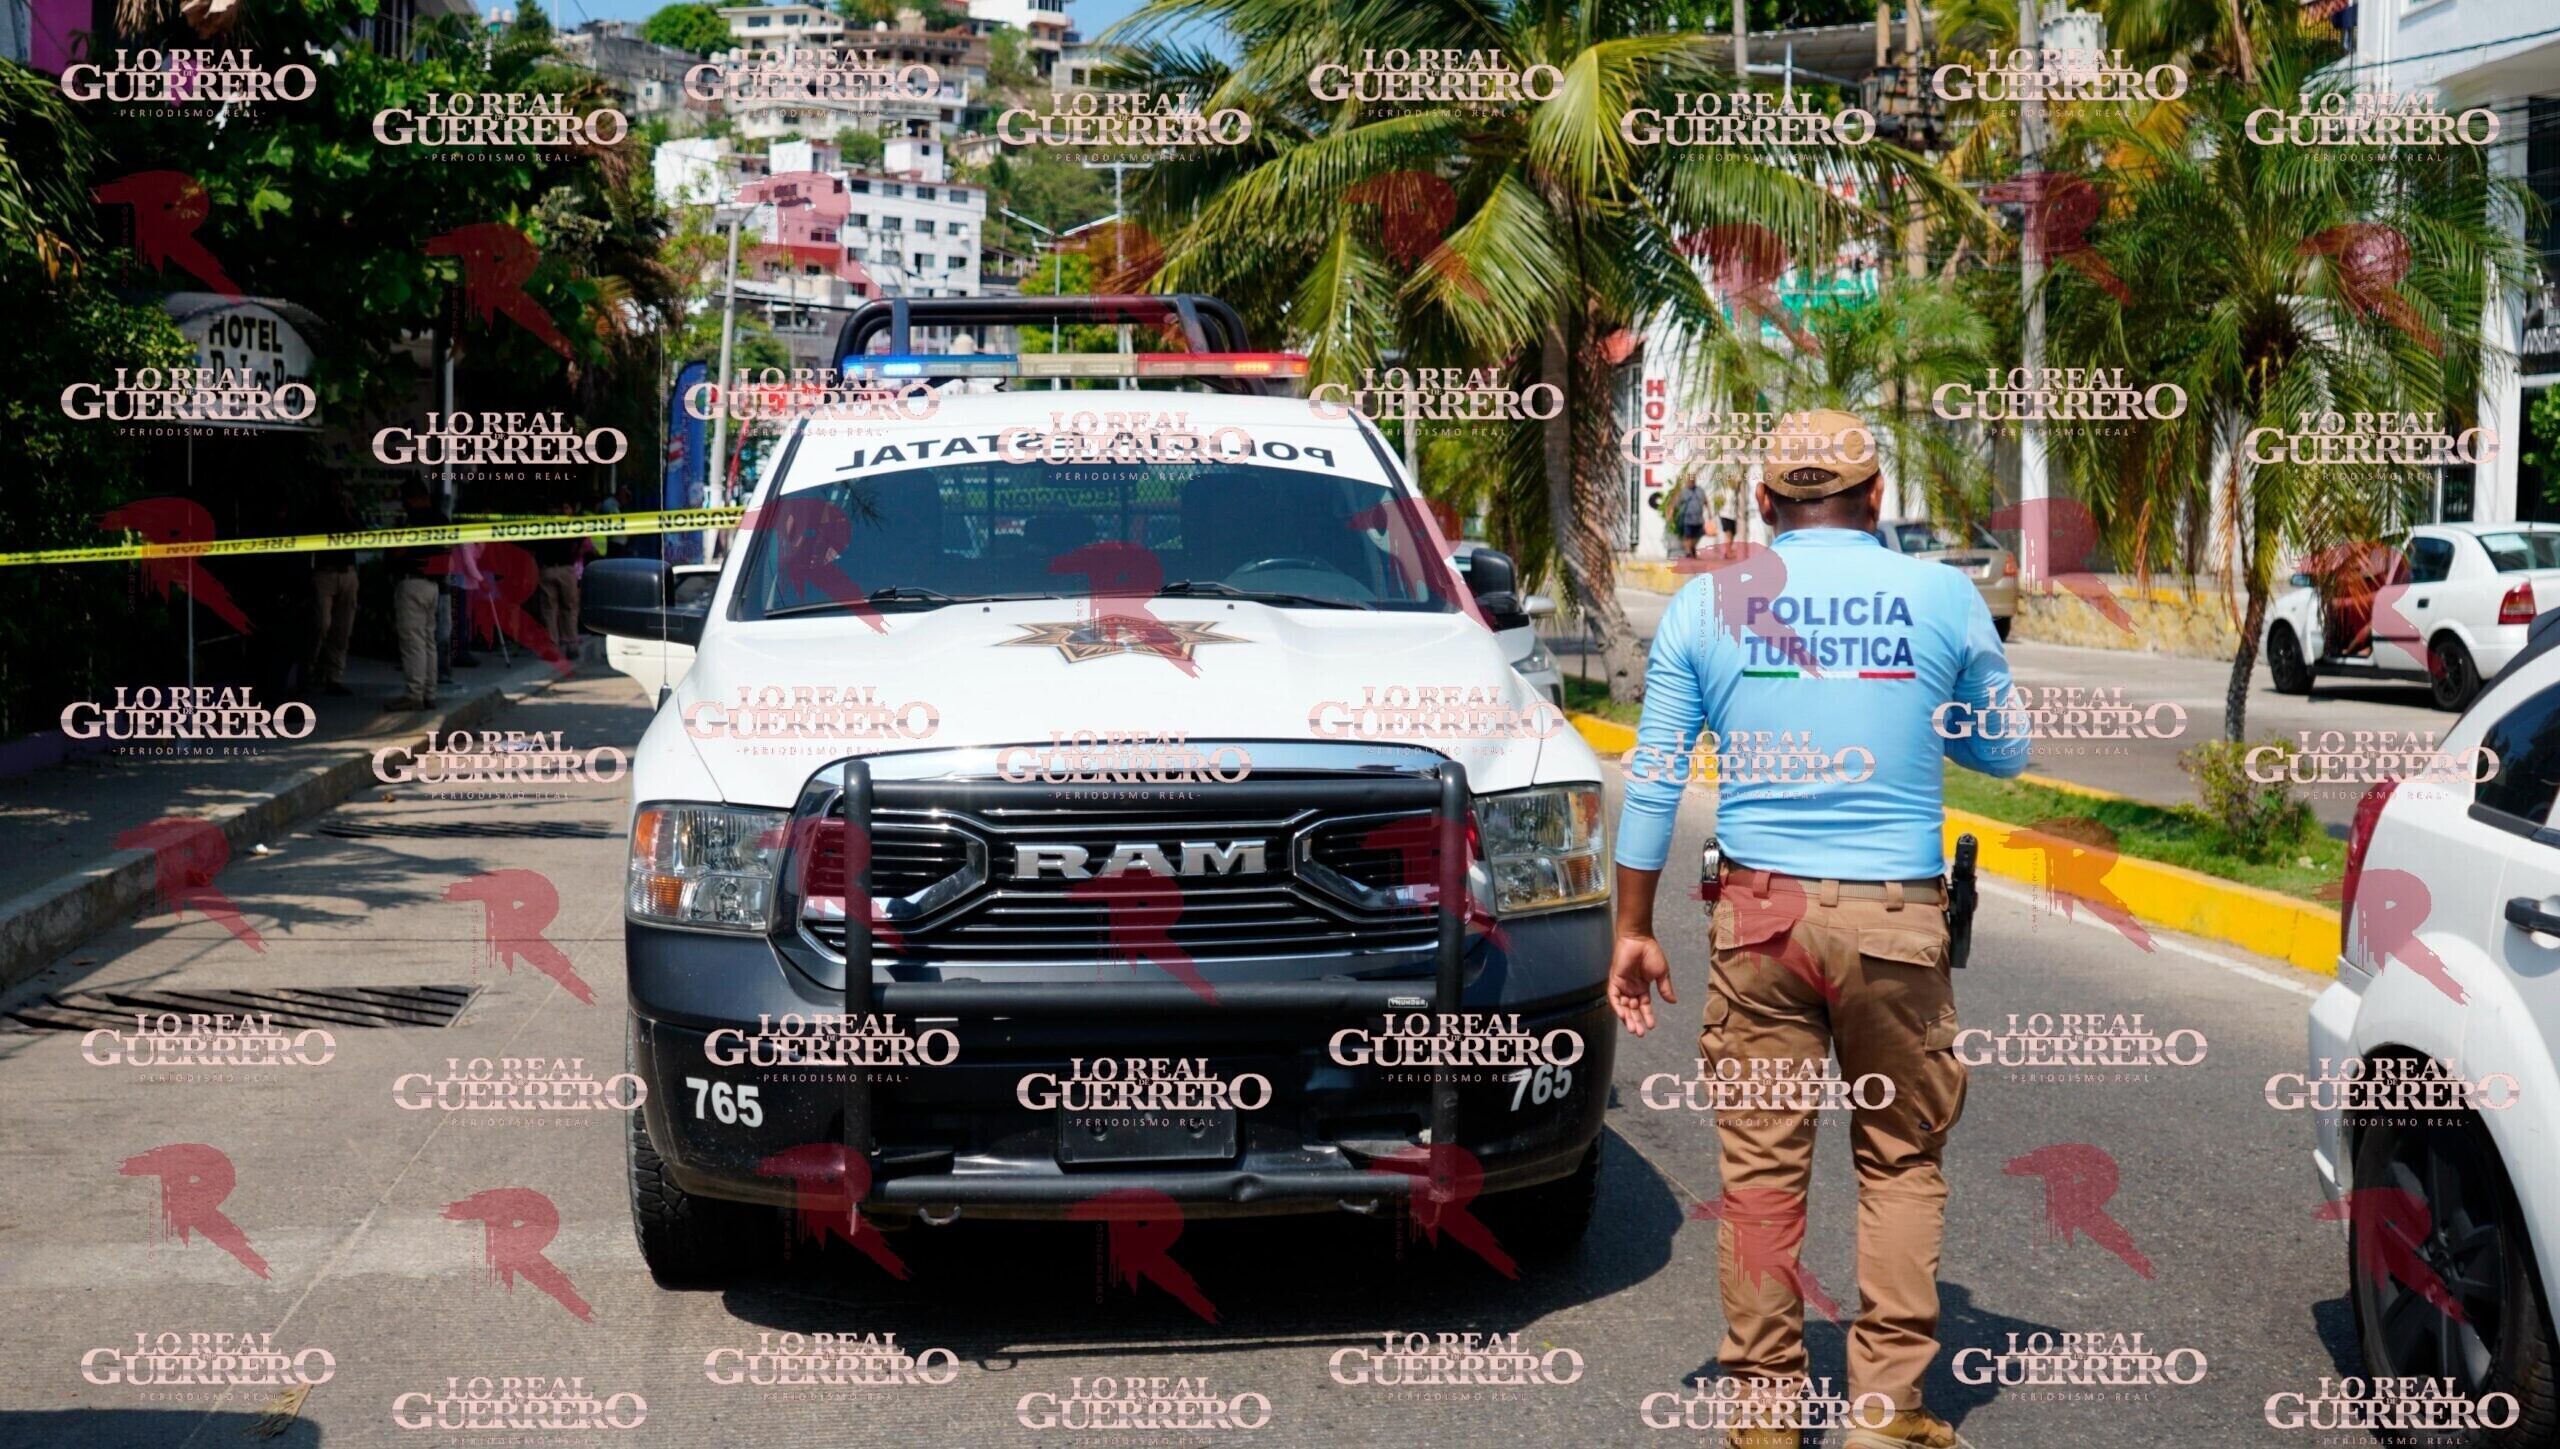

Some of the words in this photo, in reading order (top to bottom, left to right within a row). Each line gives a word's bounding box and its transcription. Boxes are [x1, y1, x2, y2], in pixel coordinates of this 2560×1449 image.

[209, 315, 283, 353] HOTEL
[327, 527, 460, 546] PRECAUCION
[491, 518, 625, 537] PRECAUCION
[659, 511, 741, 528] AUCION
[1747, 592, 1914, 626] POLICÍA
[1745, 630, 1914, 666] TURÍSTICA
[1015, 840, 1267, 879] RAM
[685, 1077, 763, 1128] 765
[1509, 1059, 1572, 1112] 765
